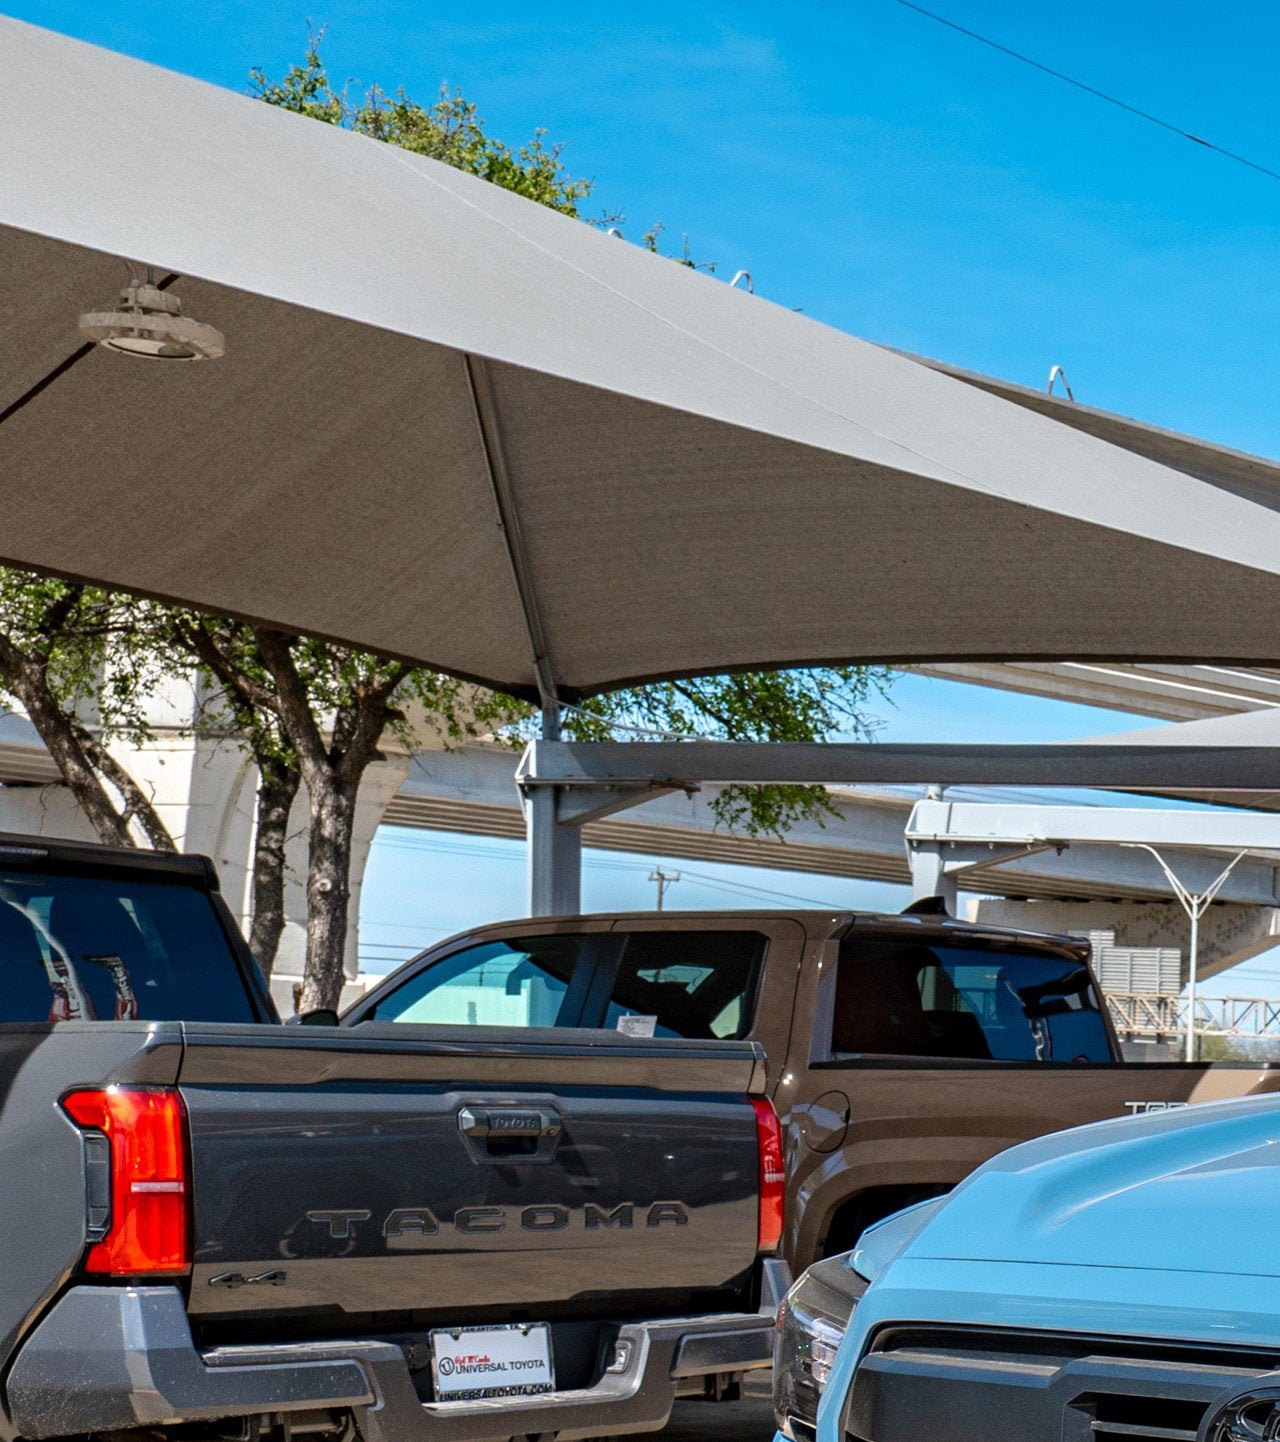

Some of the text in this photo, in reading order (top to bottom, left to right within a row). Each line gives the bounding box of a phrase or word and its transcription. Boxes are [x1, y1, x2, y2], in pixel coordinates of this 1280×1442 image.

[305, 1200, 689, 1239] TACOMA
[456, 1360, 545, 1374] UNIVERSAL TOYOTA
